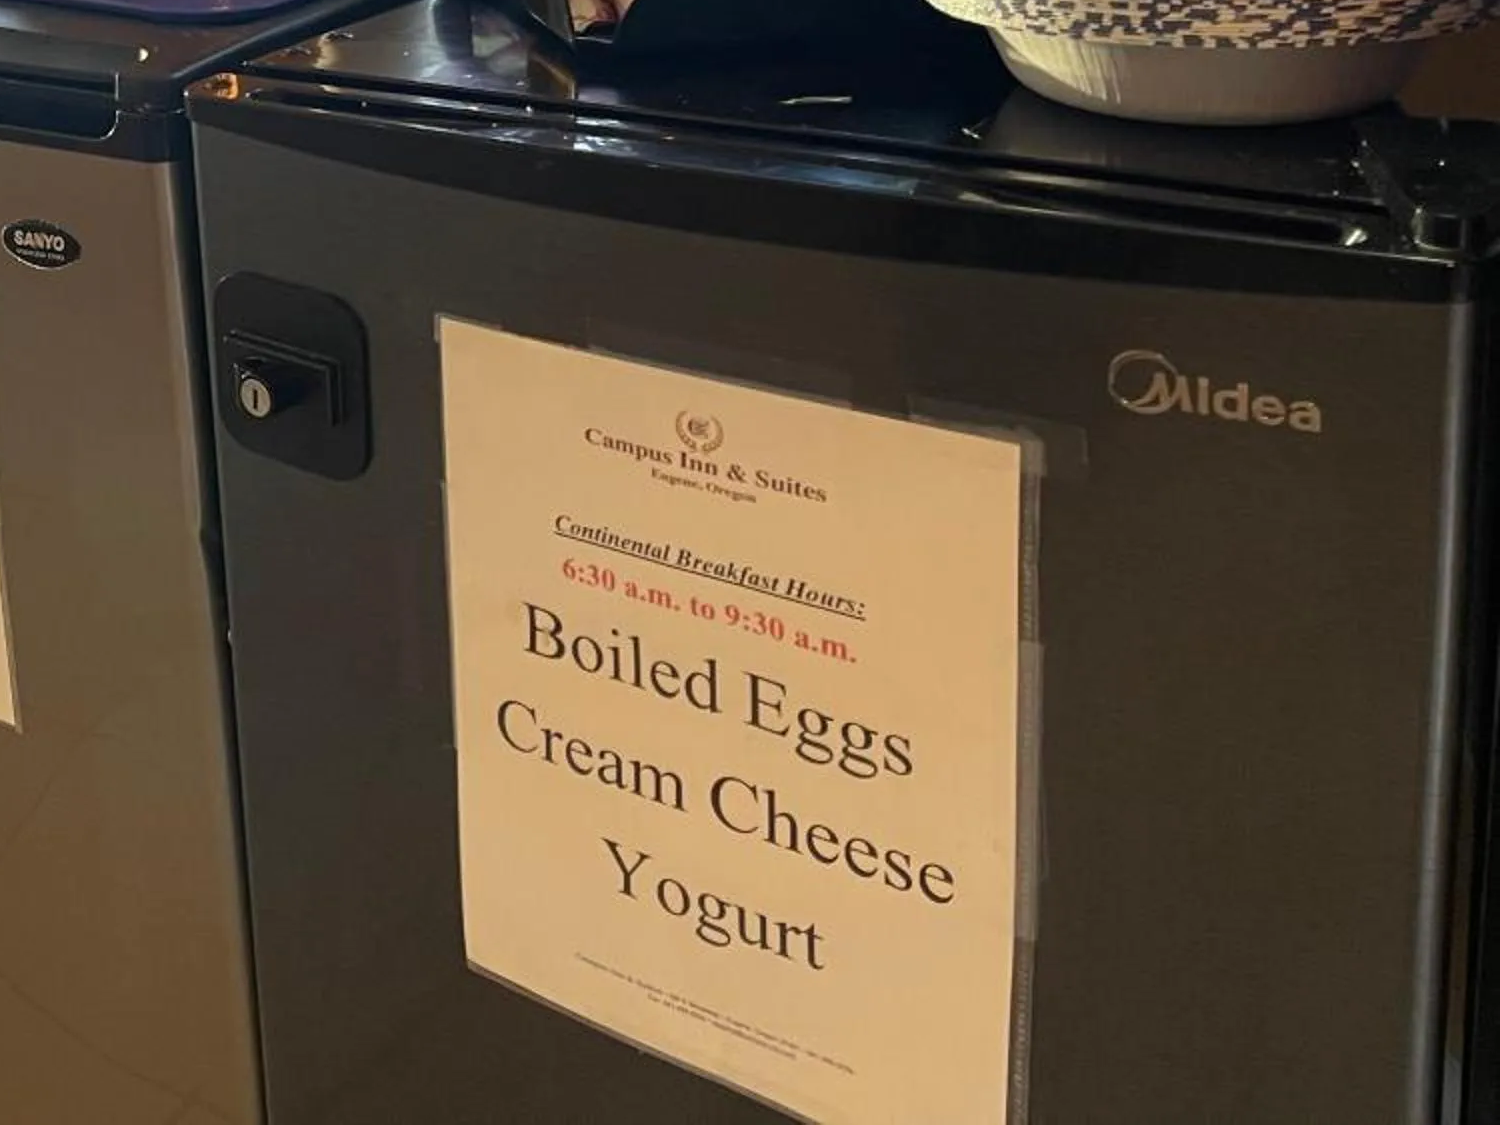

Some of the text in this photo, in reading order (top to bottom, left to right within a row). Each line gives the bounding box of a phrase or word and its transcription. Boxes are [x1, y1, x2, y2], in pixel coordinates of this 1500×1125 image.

[13, 229, 65, 251] SANYO
[1108, 350, 1322, 433] Midea
[584, 427, 827, 503] Campus Inn & Suites
[651, 467, 757, 504] Eugene, Oregon
[554, 514, 867, 620] Continental Breakfast Hours:
[562, 557, 858, 665] 6:30 a.m. to 9:30 a.m.
[522, 600, 915, 781] Boiled Eggs
[497, 699, 956, 906] Cream Cheese
[601, 837, 826, 972] Yogurt
